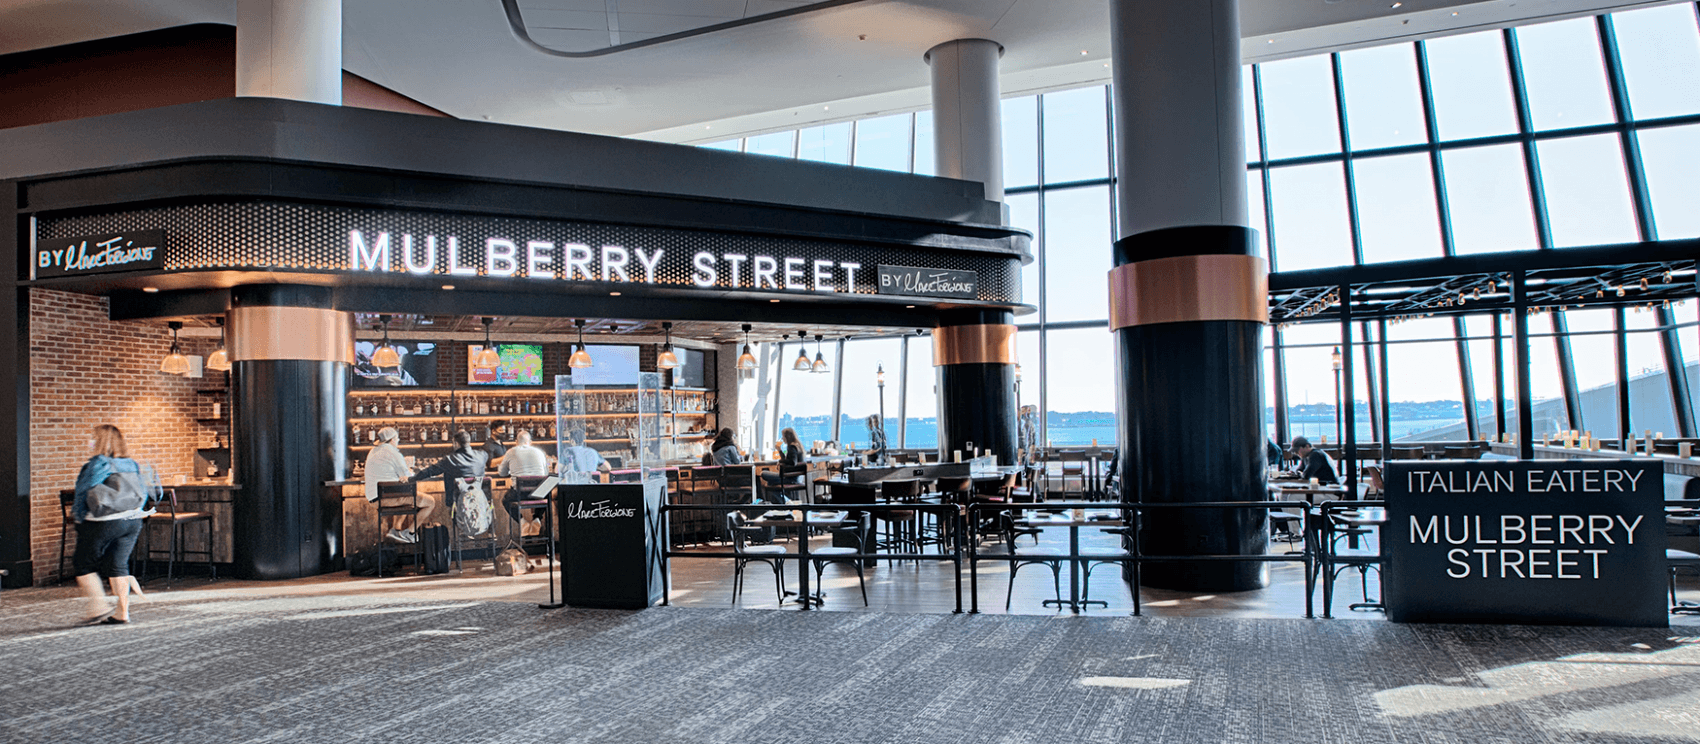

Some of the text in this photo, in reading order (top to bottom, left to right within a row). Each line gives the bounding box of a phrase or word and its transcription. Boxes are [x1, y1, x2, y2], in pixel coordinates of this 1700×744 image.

[39, 249, 63, 267] BY
[350, 229, 862, 294] MULBERRY STREET
[881, 274, 902, 287] BY
[1407, 469, 1645, 493] ITALIAN EATERY
[1409, 514, 1644, 545] MULBERRY
[1446, 548, 1608, 579] STREET
